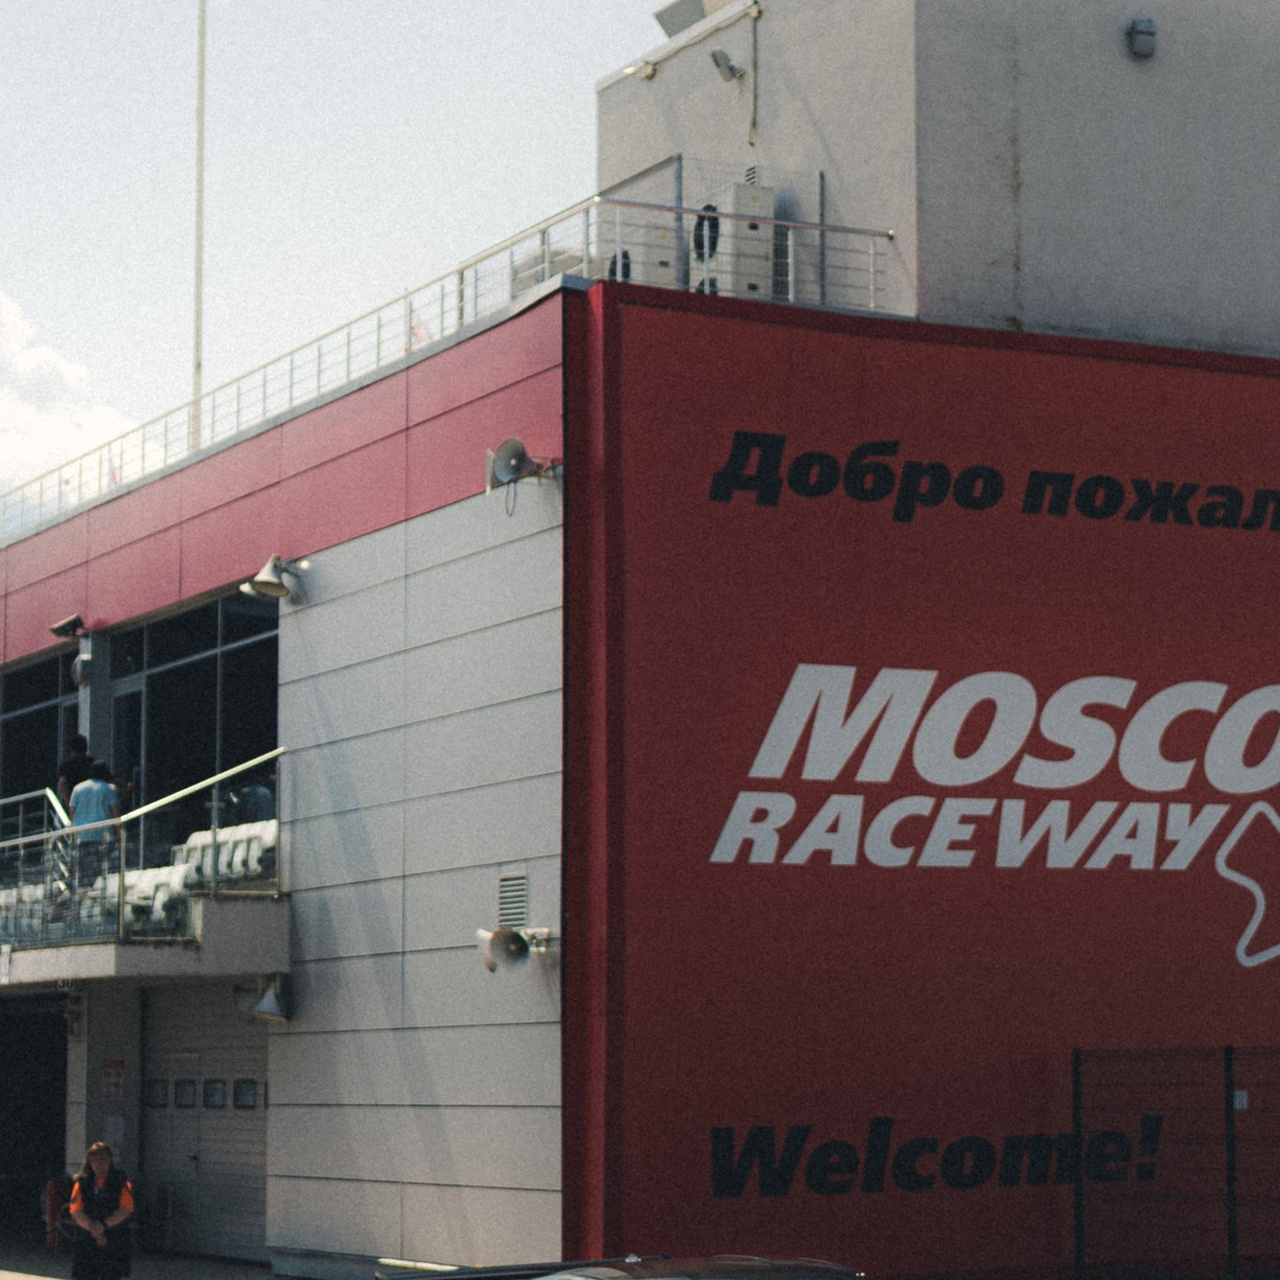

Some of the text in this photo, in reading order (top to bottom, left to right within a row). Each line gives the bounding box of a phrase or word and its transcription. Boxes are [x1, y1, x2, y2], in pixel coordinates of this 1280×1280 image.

[708, 430, 1005, 523] Добро
[709, 791, 1230, 870] RACEWAY
[710, 1113, 1165, 1200] Welcome!
